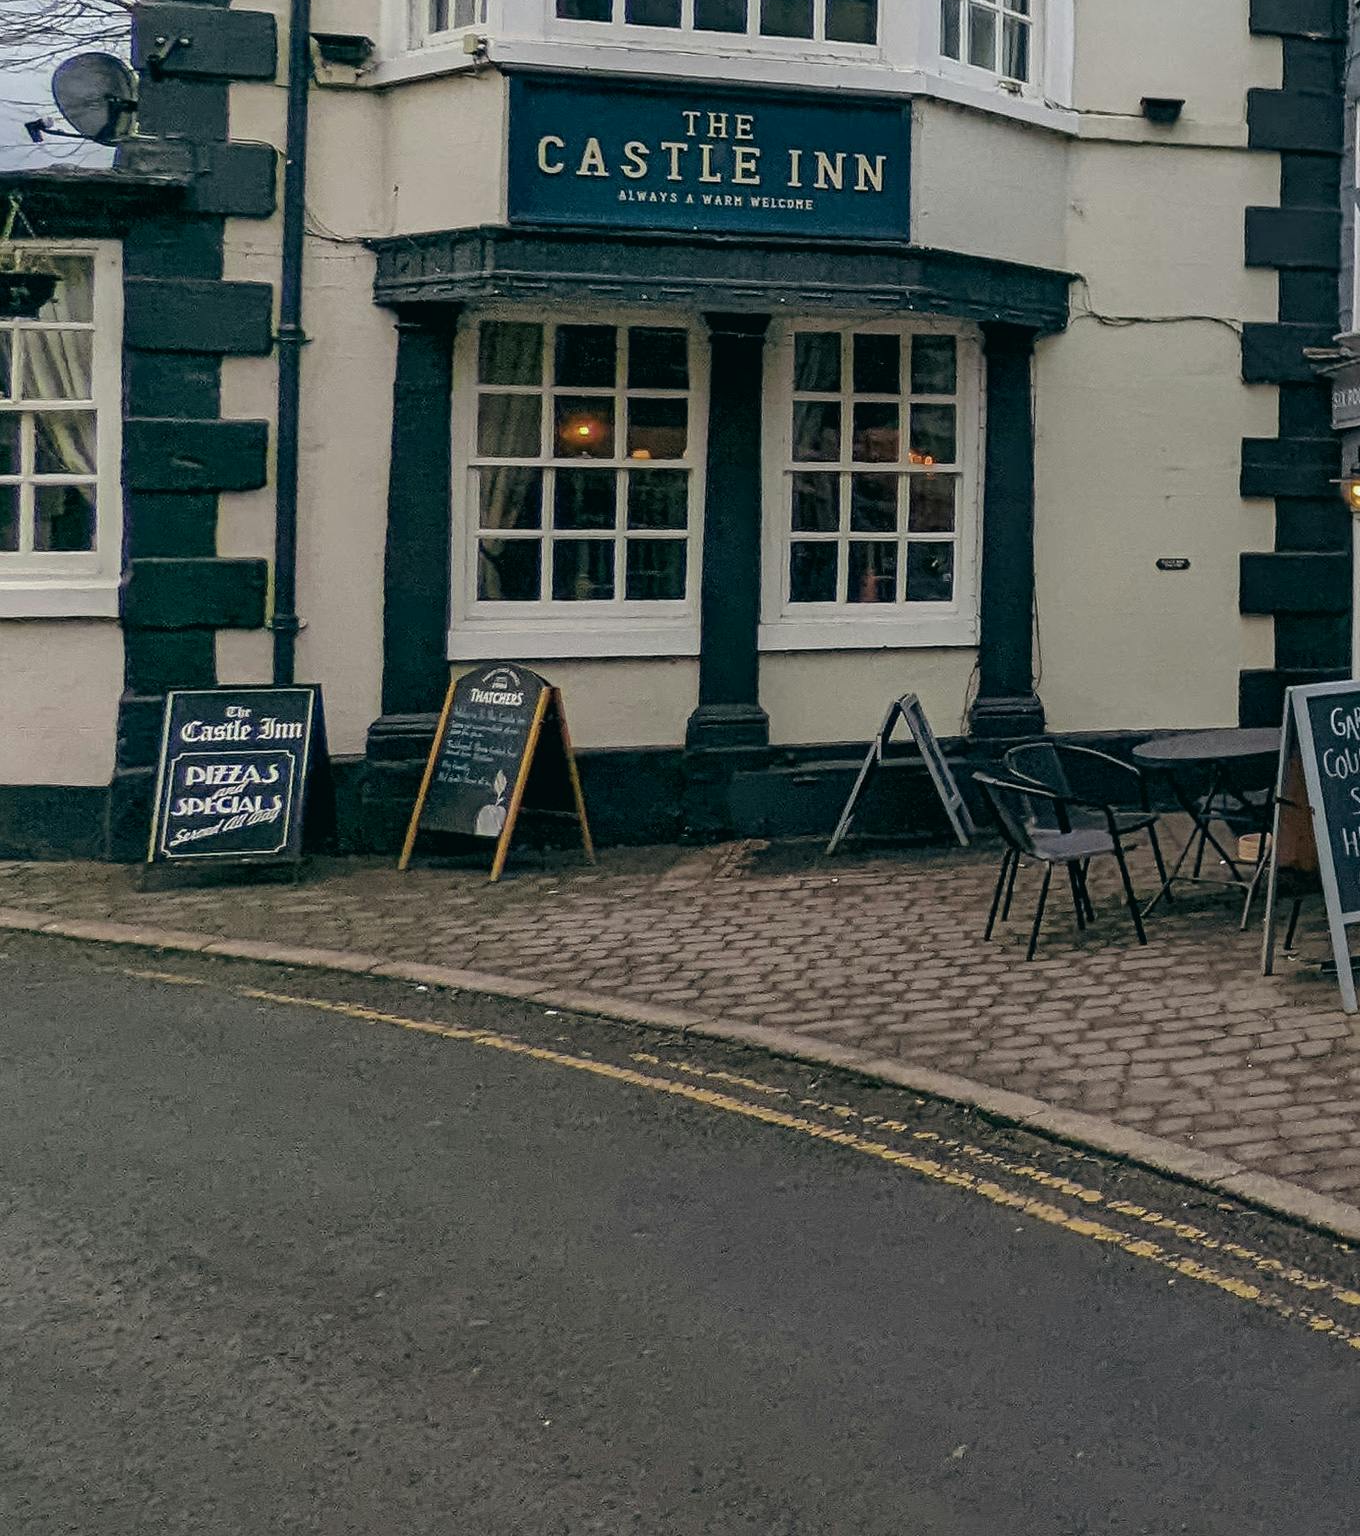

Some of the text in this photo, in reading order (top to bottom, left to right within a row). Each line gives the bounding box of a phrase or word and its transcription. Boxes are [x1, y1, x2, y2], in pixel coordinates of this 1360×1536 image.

[682, 110, 755, 141] THE
[537, 135, 887, 192] CASTLE INN
[617, 190, 815, 210] ALWAYS A WARM WELCOME
[470, 688, 525, 706] THATCHERS
[225, 705, 252, 718] The
[181, 718, 303, 742] Castle Inn
[185, 764, 279, 786] PIZZAS
[211, 780, 249, 799] and
[171, 794, 282, 816] SPECIALS
